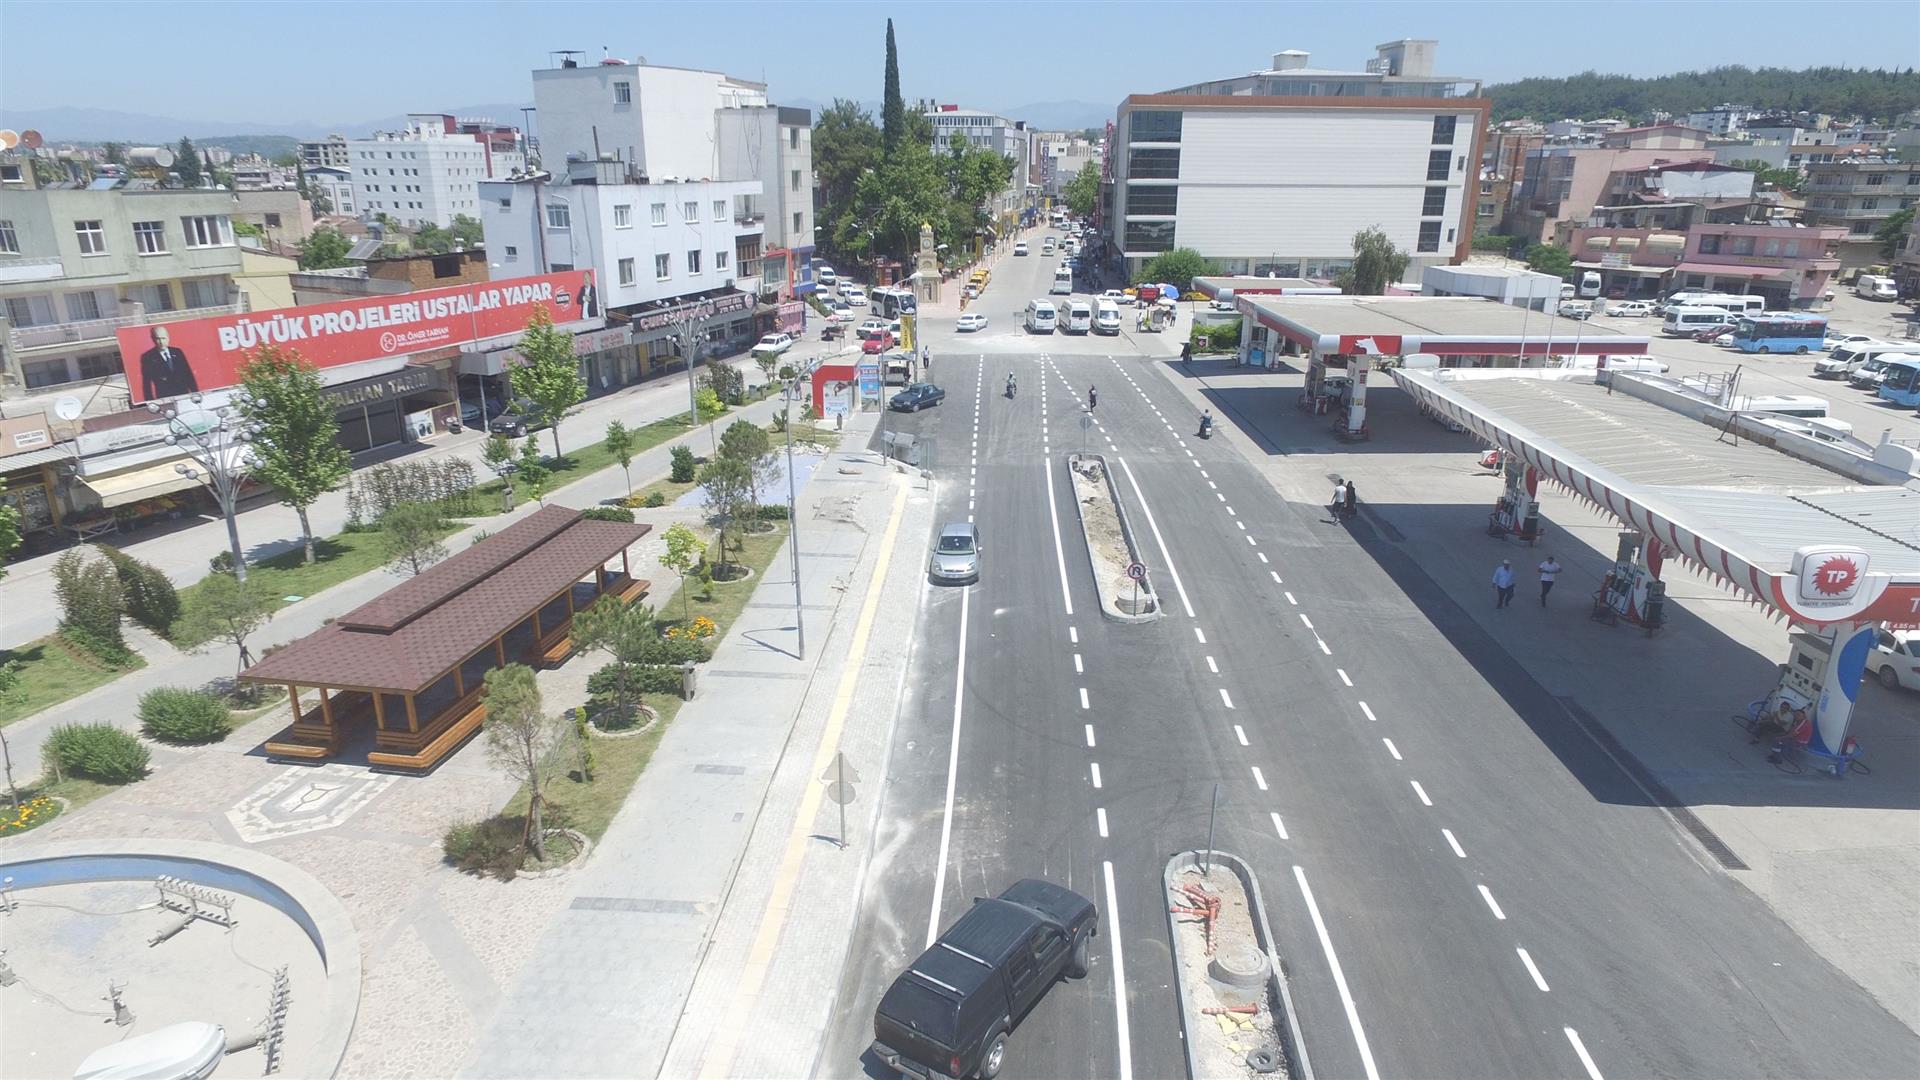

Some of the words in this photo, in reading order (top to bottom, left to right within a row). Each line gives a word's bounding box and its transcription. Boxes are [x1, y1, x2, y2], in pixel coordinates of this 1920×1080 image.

[217, 316, 304, 351] BÜYÜK
[423, 288, 501, 321] USTALAR
[501, 282, 553, 306] YAPAR
[1826, 570, 1848, 583] TP
